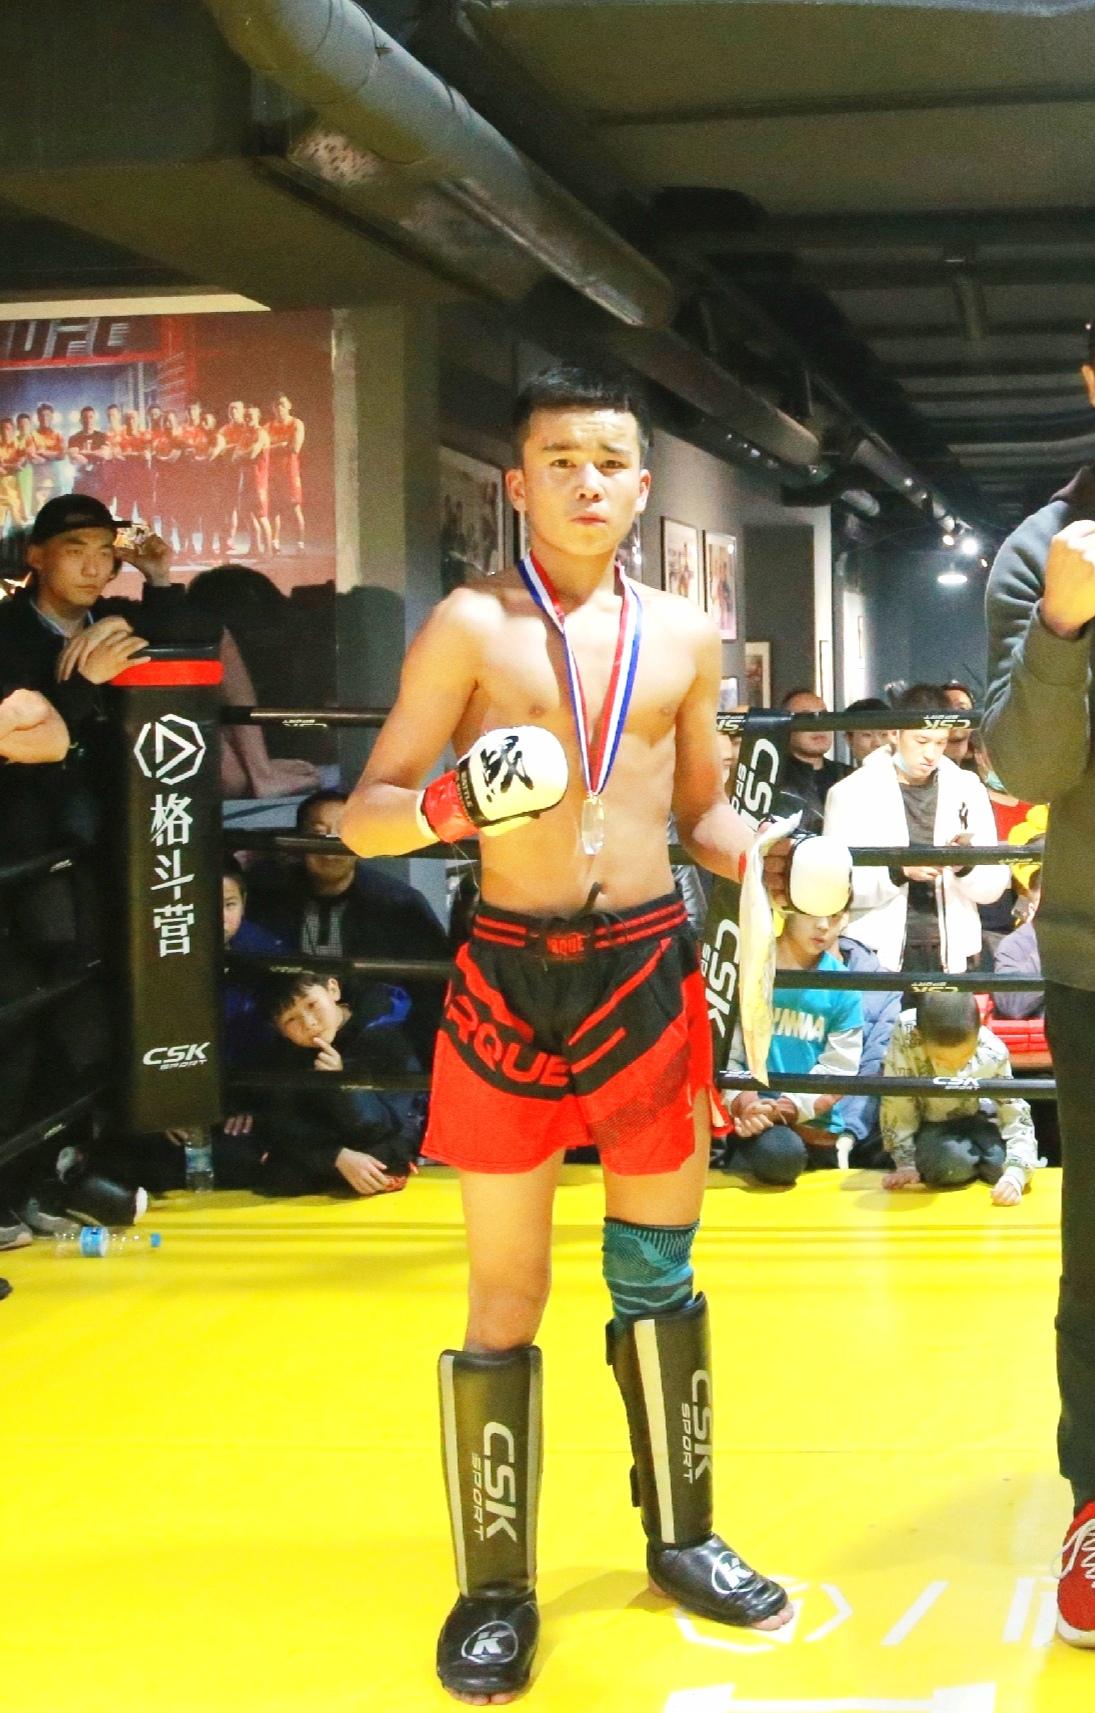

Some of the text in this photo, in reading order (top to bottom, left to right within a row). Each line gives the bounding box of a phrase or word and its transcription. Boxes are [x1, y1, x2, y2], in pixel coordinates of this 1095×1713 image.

[150, 793, 195, 958] 格斗营
[143, 1041, 211, 1066] CSK
[160, 1059, 208, 1071] SPORT
[681, 1401, 693, 1484] SPORT
[691, 1369, 714, 1480] CSK
[471, 1452, 484, 1542] SPORT
[483, 1421, 518, 1543] CSK
